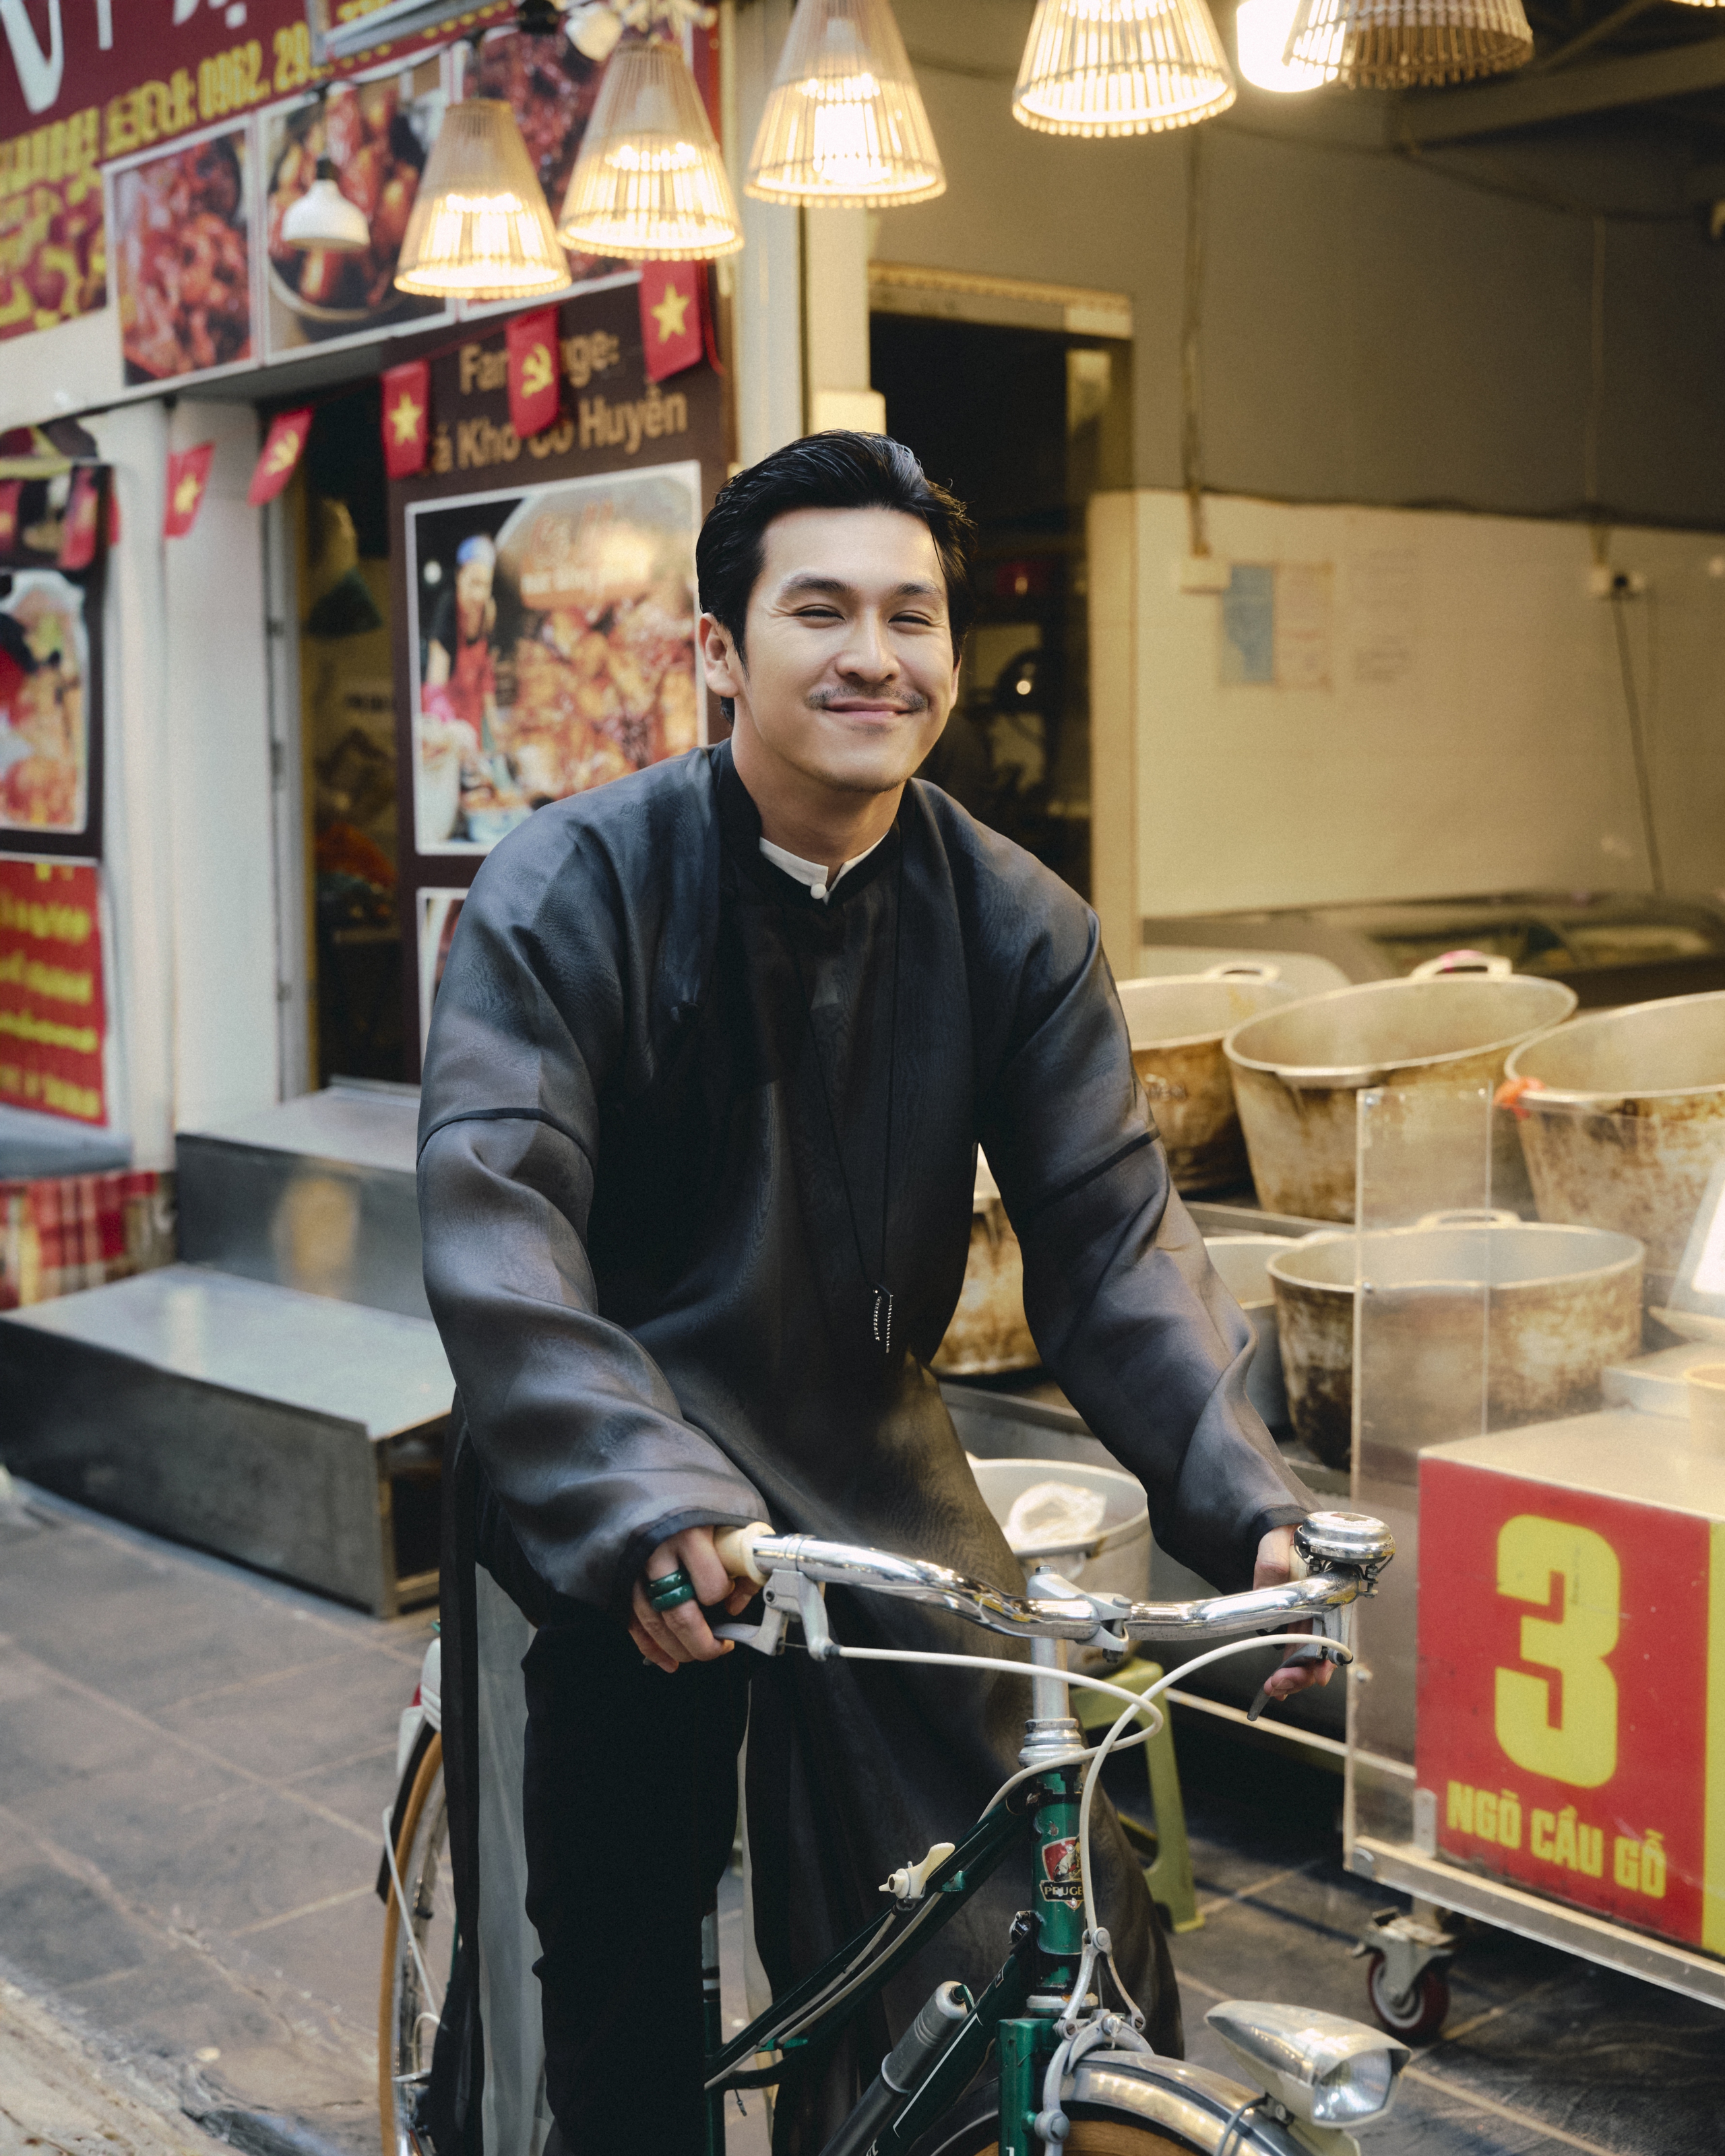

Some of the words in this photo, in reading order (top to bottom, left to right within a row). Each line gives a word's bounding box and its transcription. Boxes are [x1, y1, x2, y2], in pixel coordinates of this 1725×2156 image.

[1495, 1514, 1620, 1789] 3
[1447, 1780, 1522, 1849] NGÕ
[1044, 1886, 1082, 1895] PEUGE
